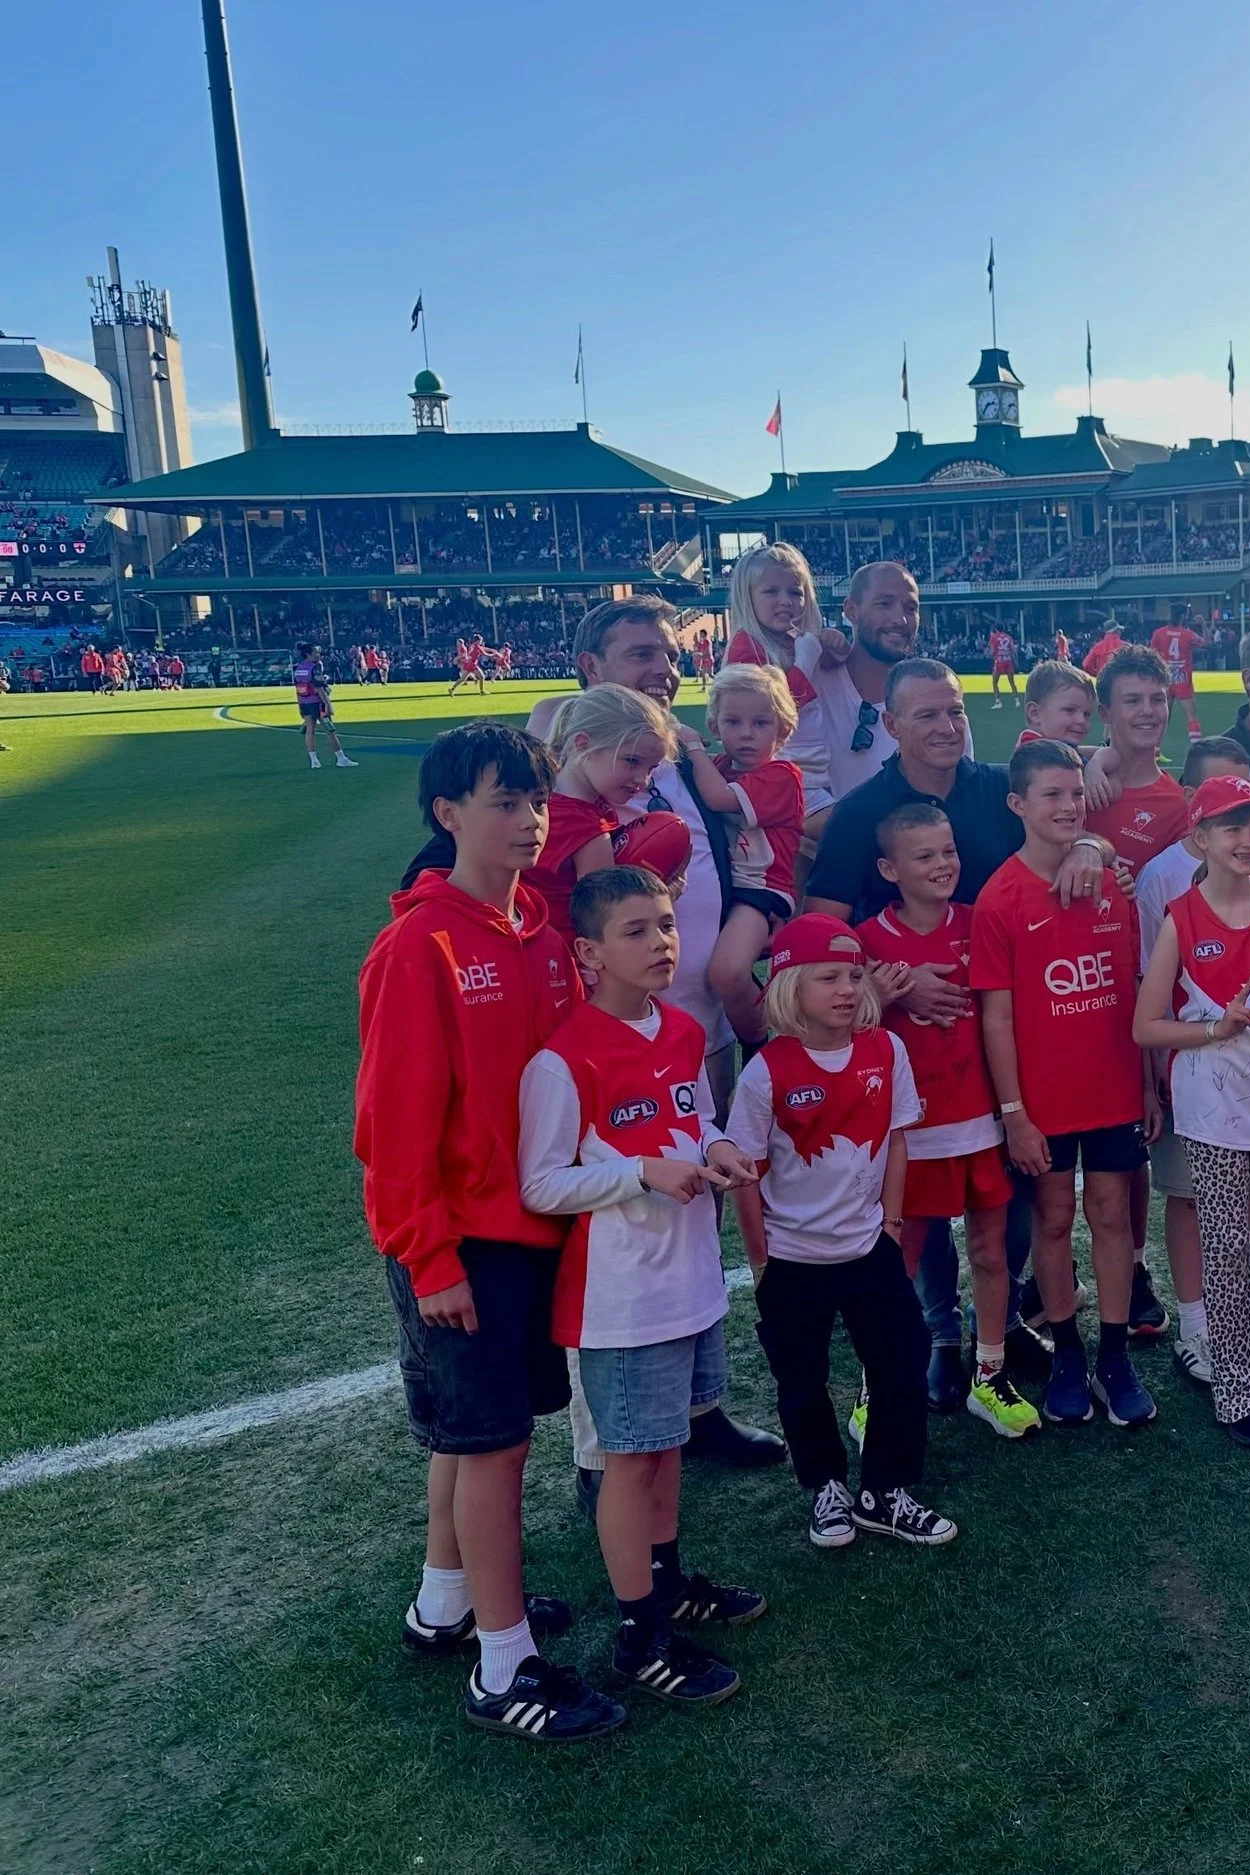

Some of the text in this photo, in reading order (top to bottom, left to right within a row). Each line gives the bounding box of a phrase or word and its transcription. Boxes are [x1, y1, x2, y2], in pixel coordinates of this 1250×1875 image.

[1168, 637, 1180, 660] 4
[1195, 945, 1222, 957] AFL
[456, 962, 501, 991] QBE
[1044, 951, 1114, 996] QBE
[1051, 992, 1118, 1016] Insurance
[856, 1066, 884, 1076] SYDNEY
[789, 1089, 822, 1106] AFL
[614, 1103, 655, 1125] AFL
